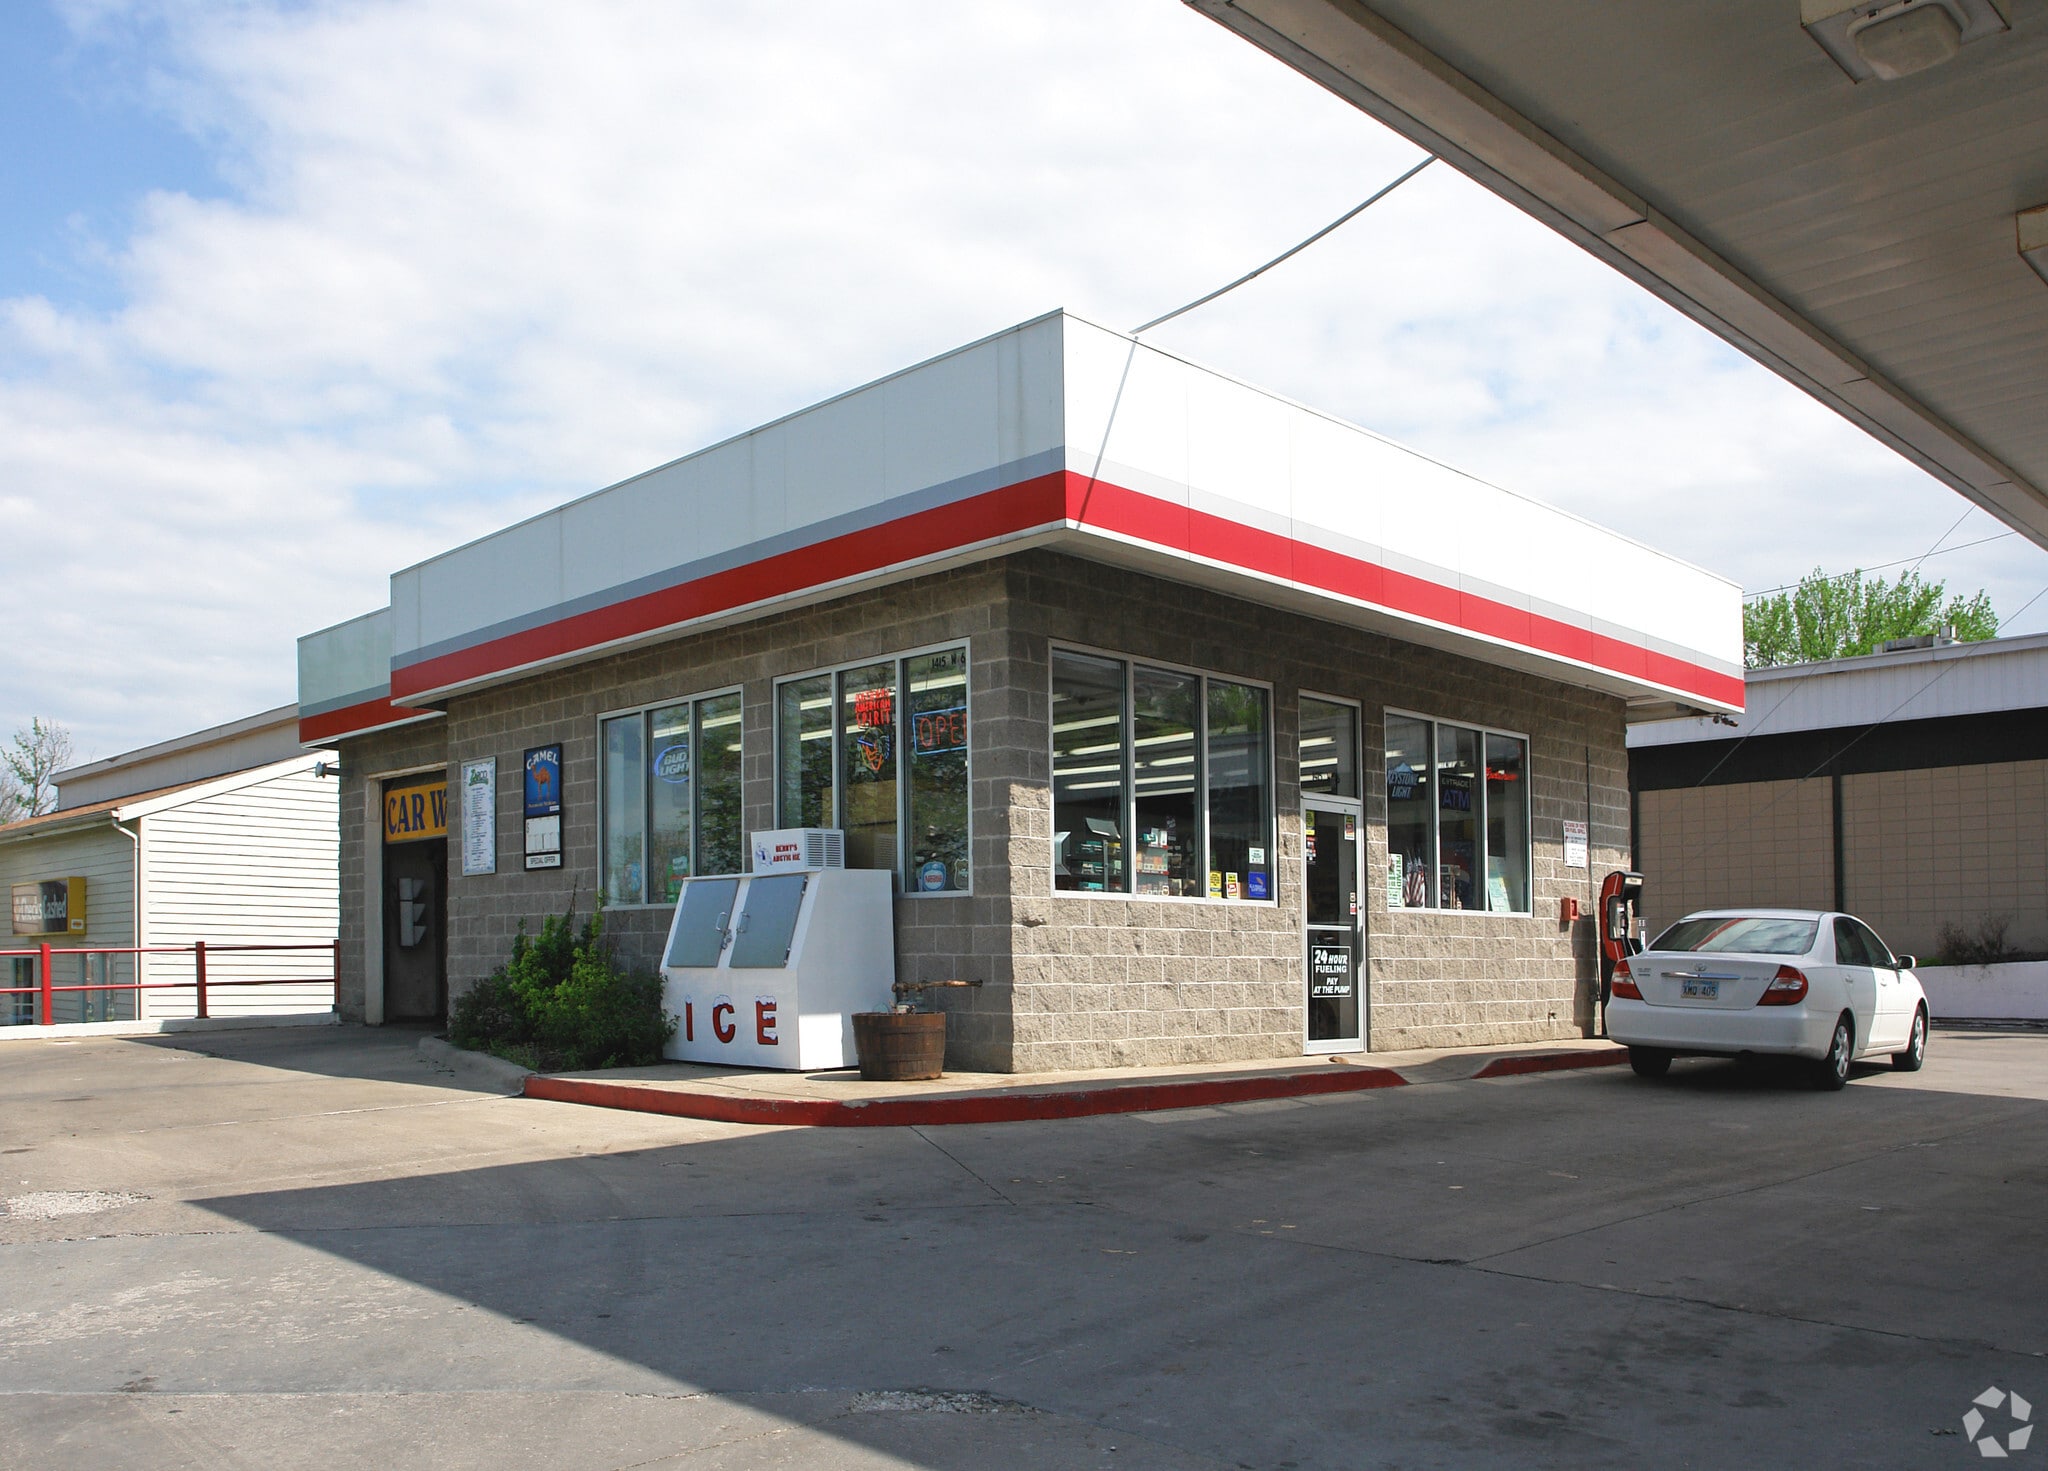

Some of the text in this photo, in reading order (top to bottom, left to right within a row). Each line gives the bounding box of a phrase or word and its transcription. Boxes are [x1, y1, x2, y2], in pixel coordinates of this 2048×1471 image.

[932, 656, 946, 669] 1415
[856, 709, 890, 728] SPIRIT
[526, 750, 559, 770] CAMEL
[663, 751, 687, 765] BUD
[1387, 769, 1420, 786] KEYSTONE
[1391, 785, 1412, 799] LIGHT
[1442, 789, 1470, 808] ATM
[387, 793, 425, 835] CAR
[43, 893, 67, 920] Cashed
[1314, 950, 1348, 965] 24 HOUR
[1315, 965, 1347, 973] FUELING
[1326, 977, 1338, 986] PAY
[1314, 986, 1350, 994] AT THE PUMP
[1701, 986, 1716, 997] 405
[684, 994, 778, 1046] ICE
